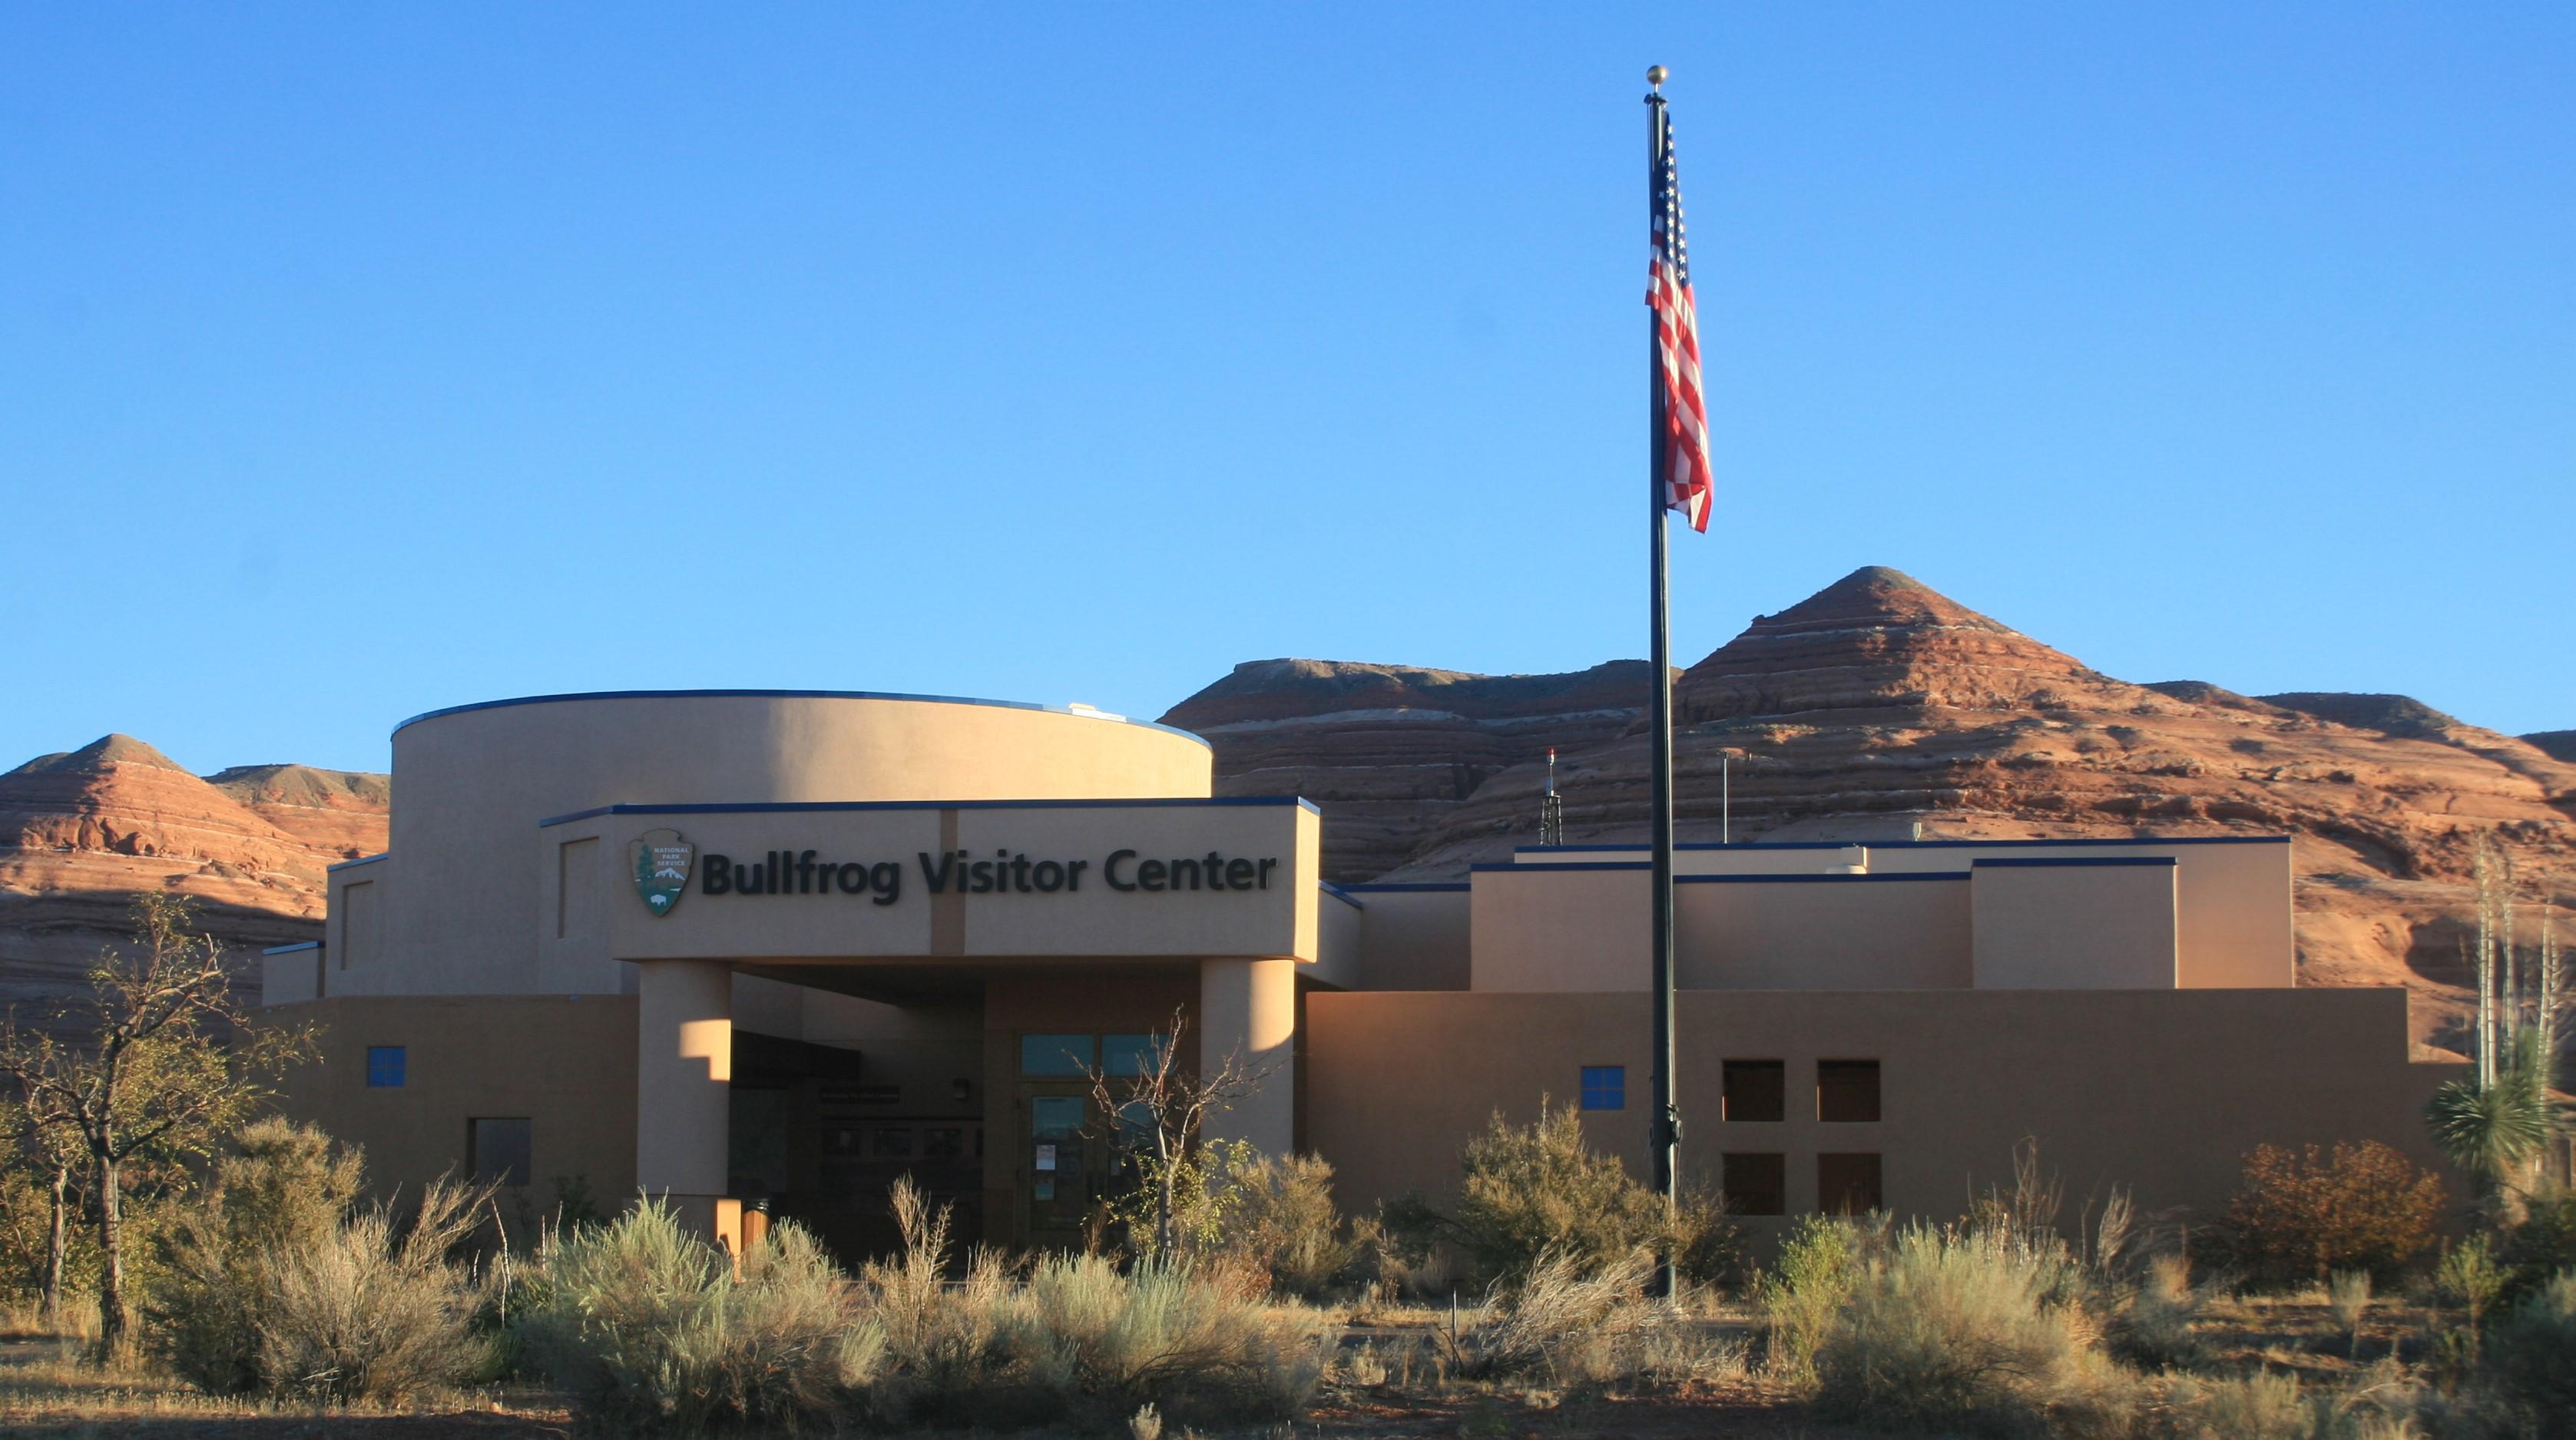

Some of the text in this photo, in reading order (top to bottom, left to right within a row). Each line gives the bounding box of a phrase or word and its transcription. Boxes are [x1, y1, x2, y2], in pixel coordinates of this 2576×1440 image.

[702, 849, 1278, 905] Bullfrog Visitor Center
